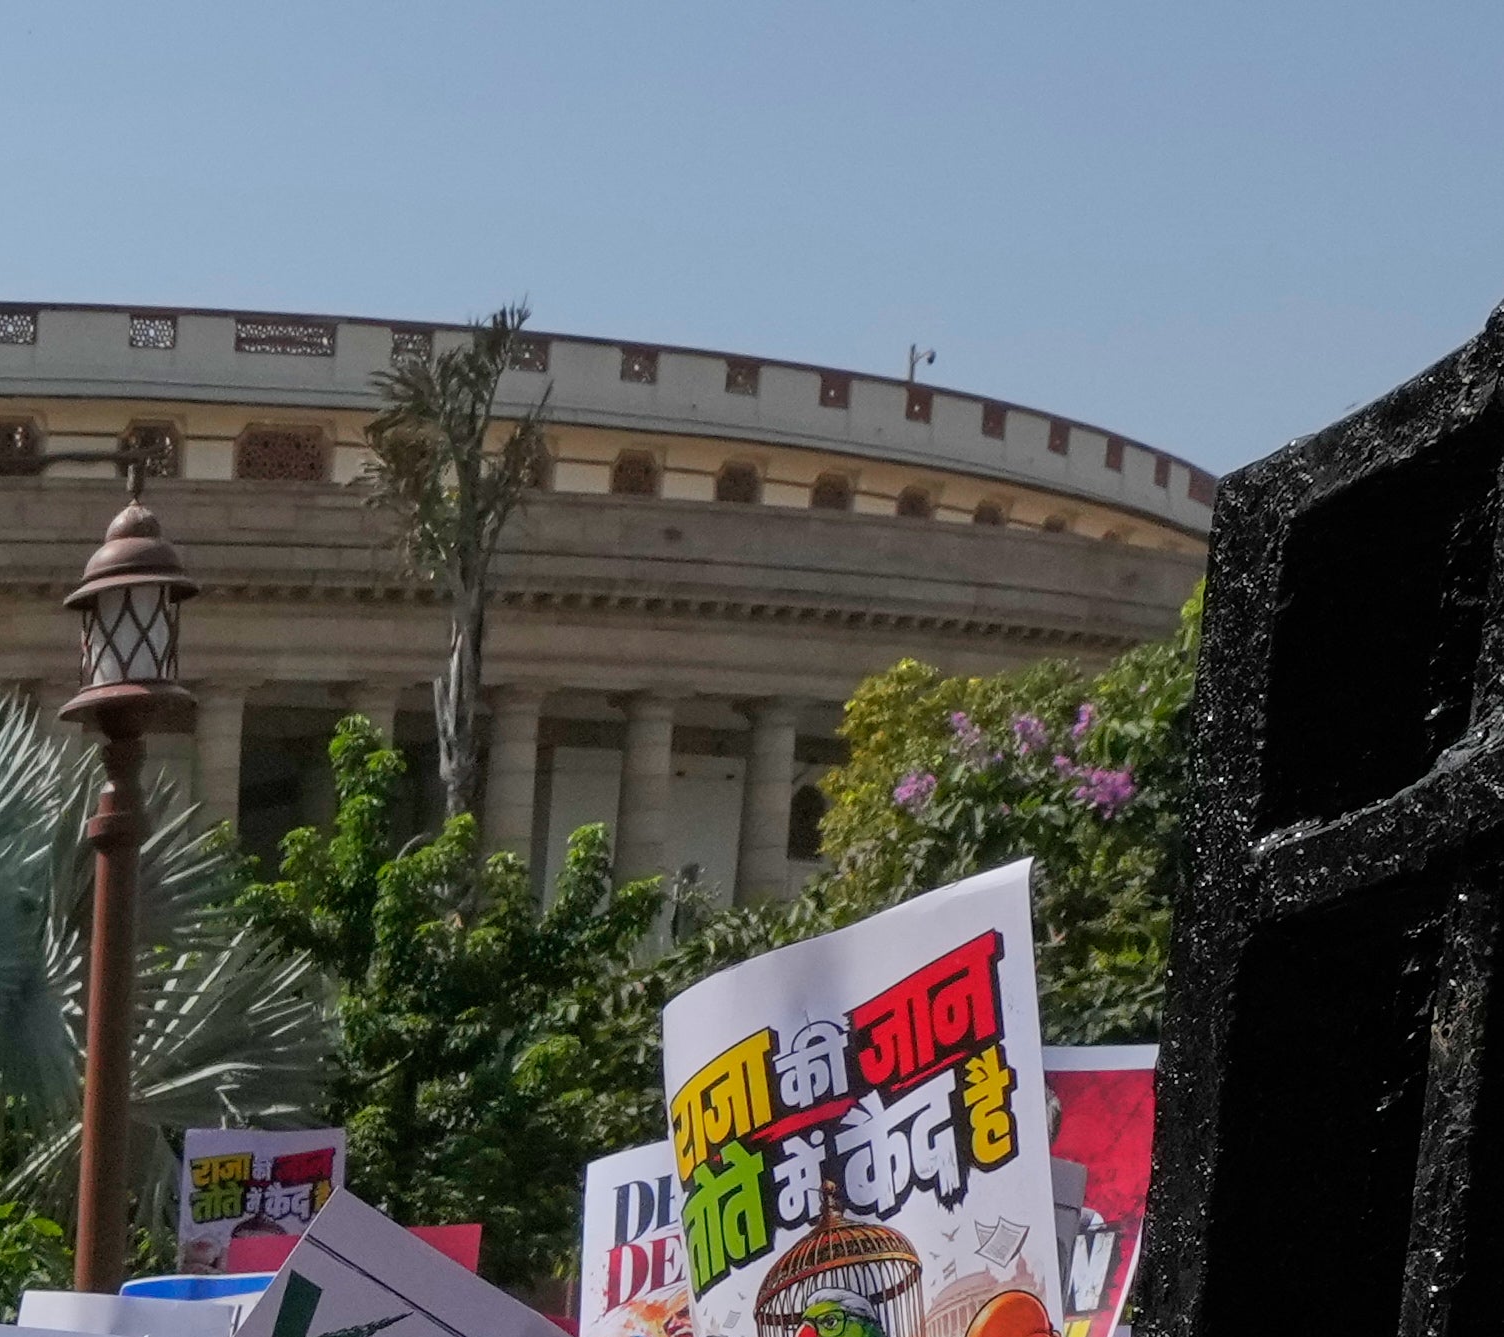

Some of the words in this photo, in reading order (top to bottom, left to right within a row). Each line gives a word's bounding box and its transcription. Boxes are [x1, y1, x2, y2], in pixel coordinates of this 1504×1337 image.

[670, 1027, 776, 1184] राजा
[773, 1021, 849, 1108] की
[850, 929, 998, 1085] जान
[684, 1141, 768, 1294] तोते
[773, 1130, 827, 1224] में
[836, 1069, 956, 1213] कैद
[964, 1044, 1012, 1165] है
